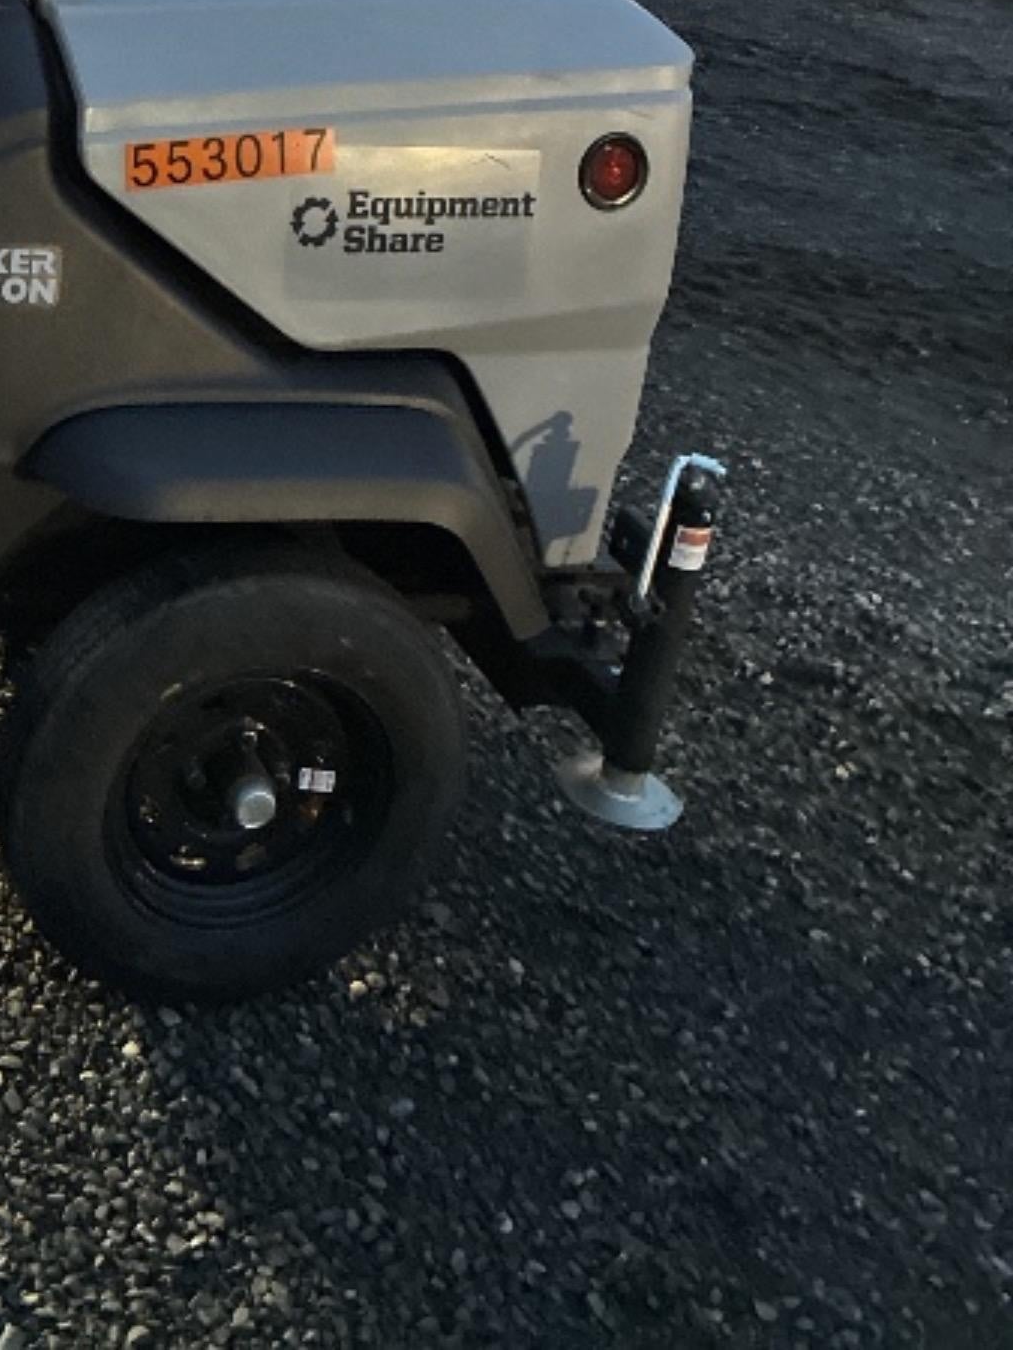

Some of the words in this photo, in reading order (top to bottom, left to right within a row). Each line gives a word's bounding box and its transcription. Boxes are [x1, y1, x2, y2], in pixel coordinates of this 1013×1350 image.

[131, 128, 328, 188] 553017
[346, 191, 537, 225] Equipment
[343, 226, 445, 254] Share
